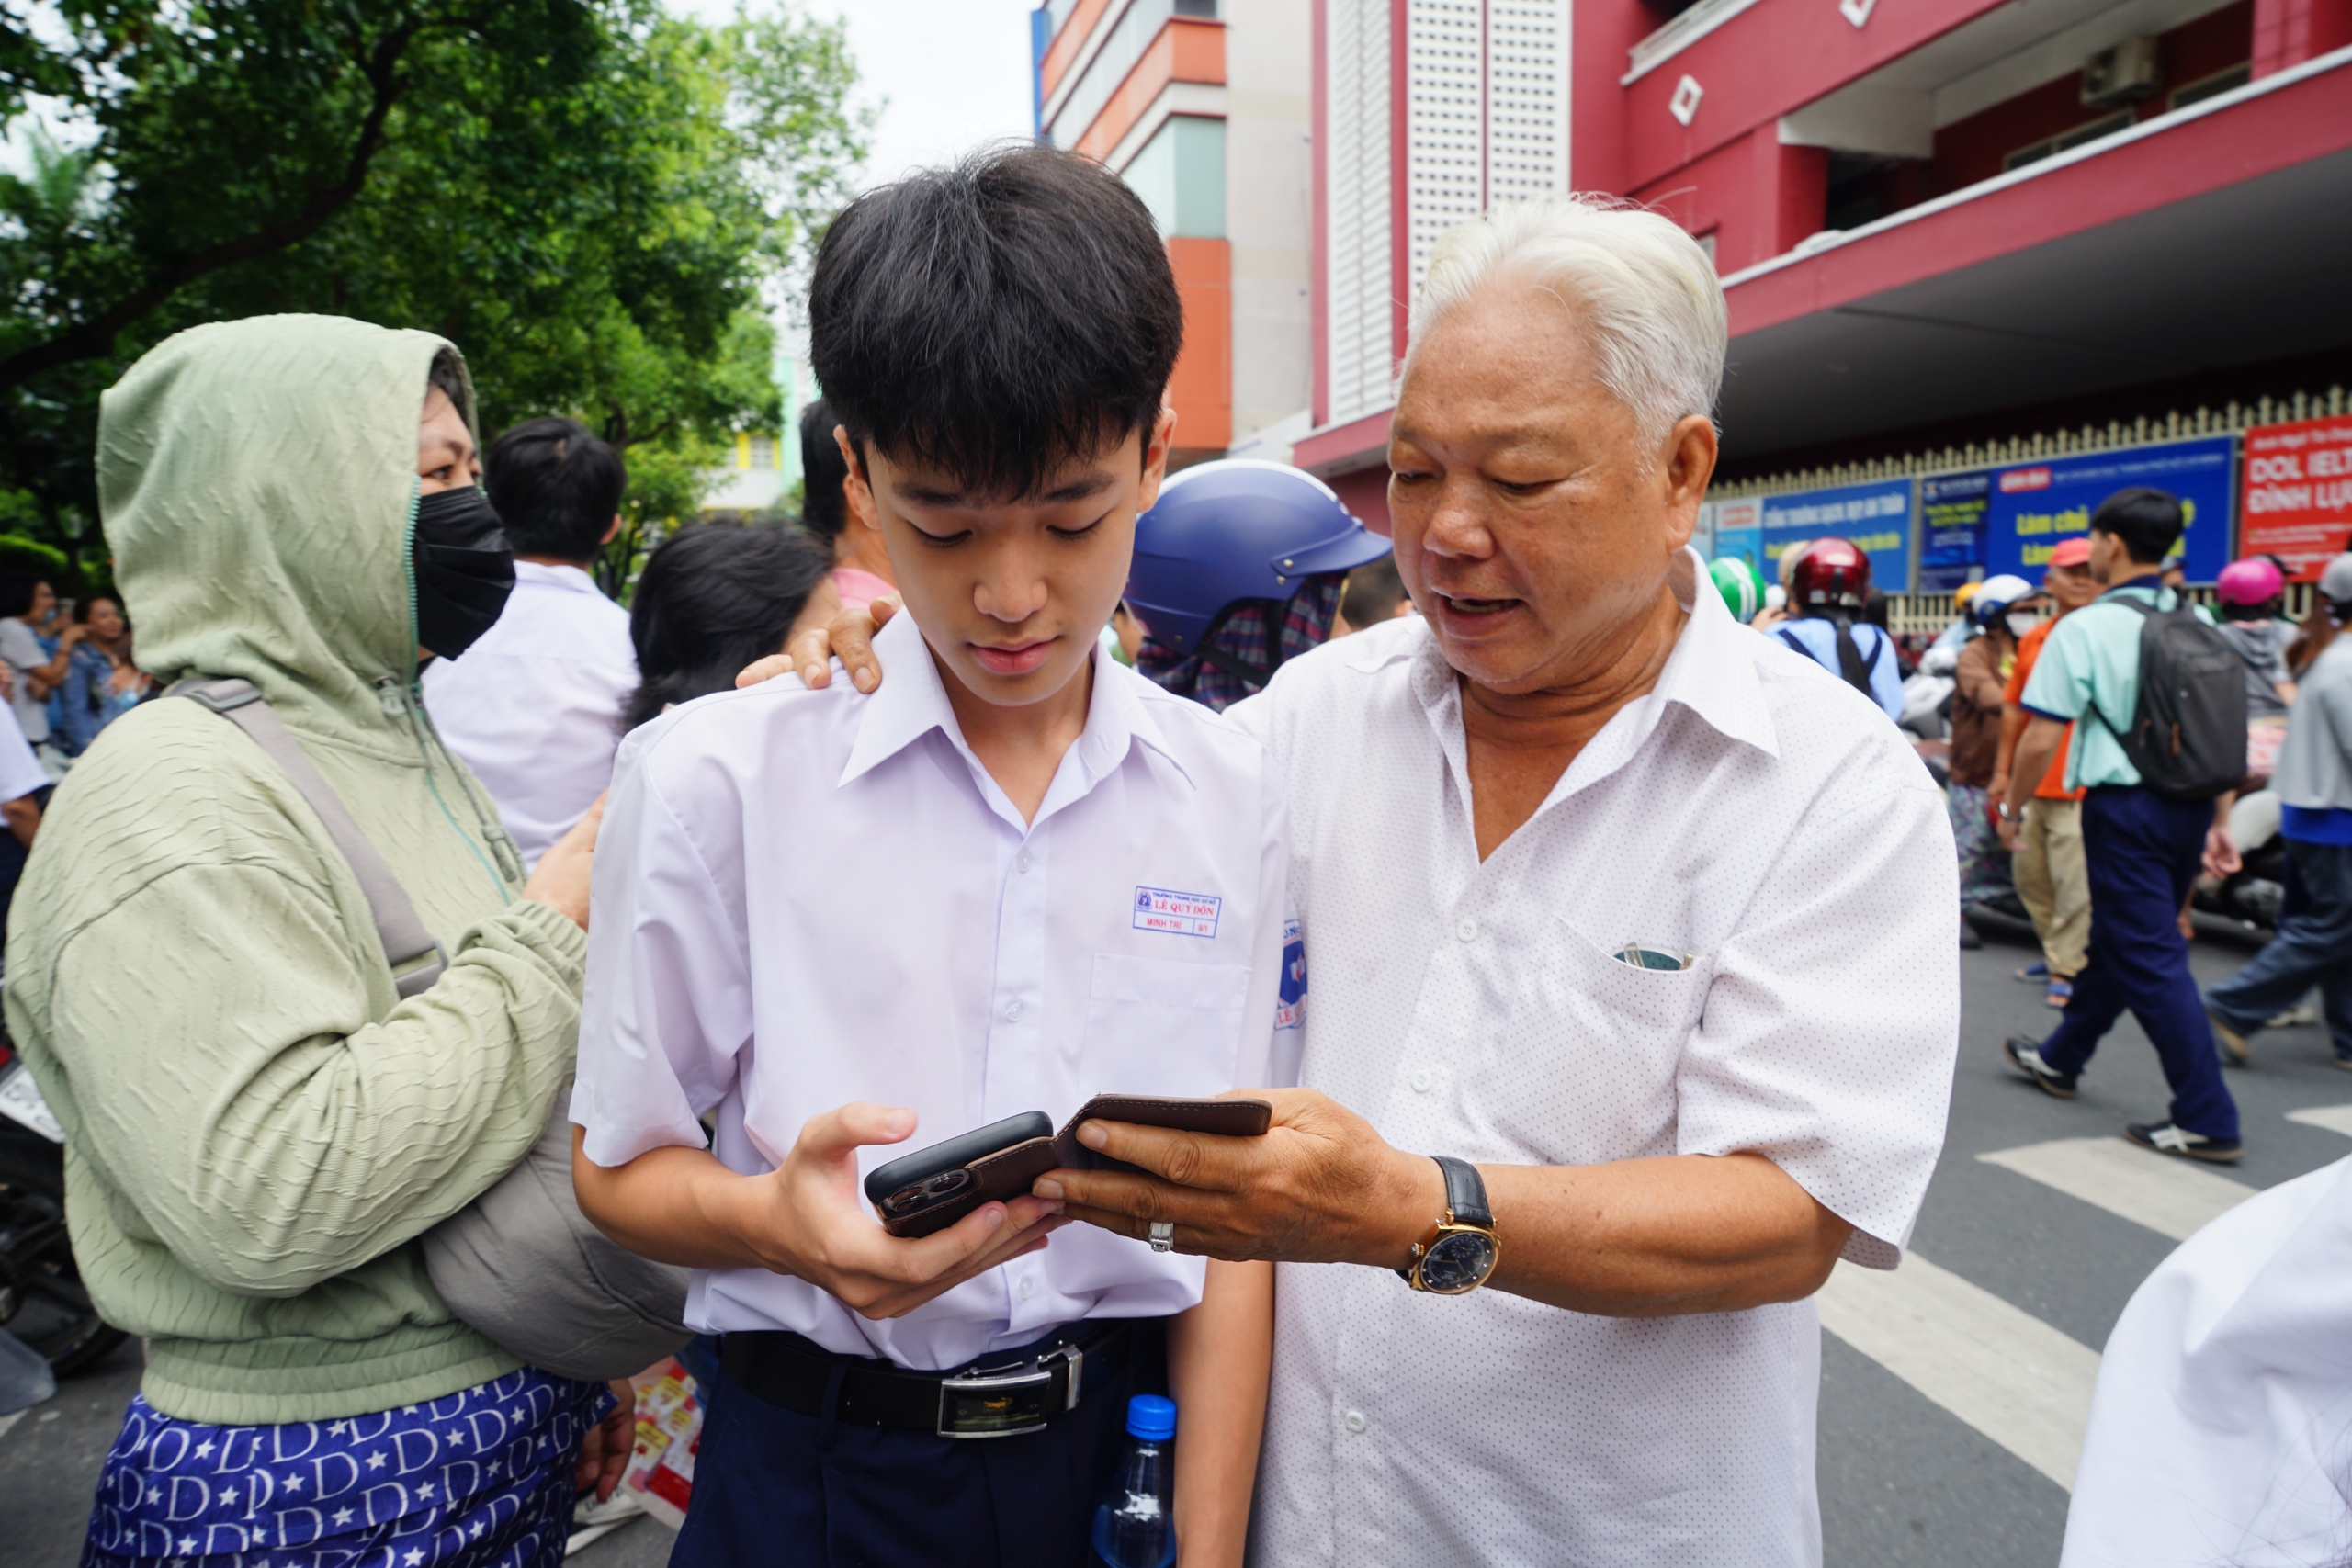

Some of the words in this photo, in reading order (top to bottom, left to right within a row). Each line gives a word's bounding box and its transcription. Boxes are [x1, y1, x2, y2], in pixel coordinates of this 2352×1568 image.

[2250, 455, 2303, 483] DOL
[1155, 899, 1168, 910] LÊ
[1147, 917, 1167, 928] MINH
